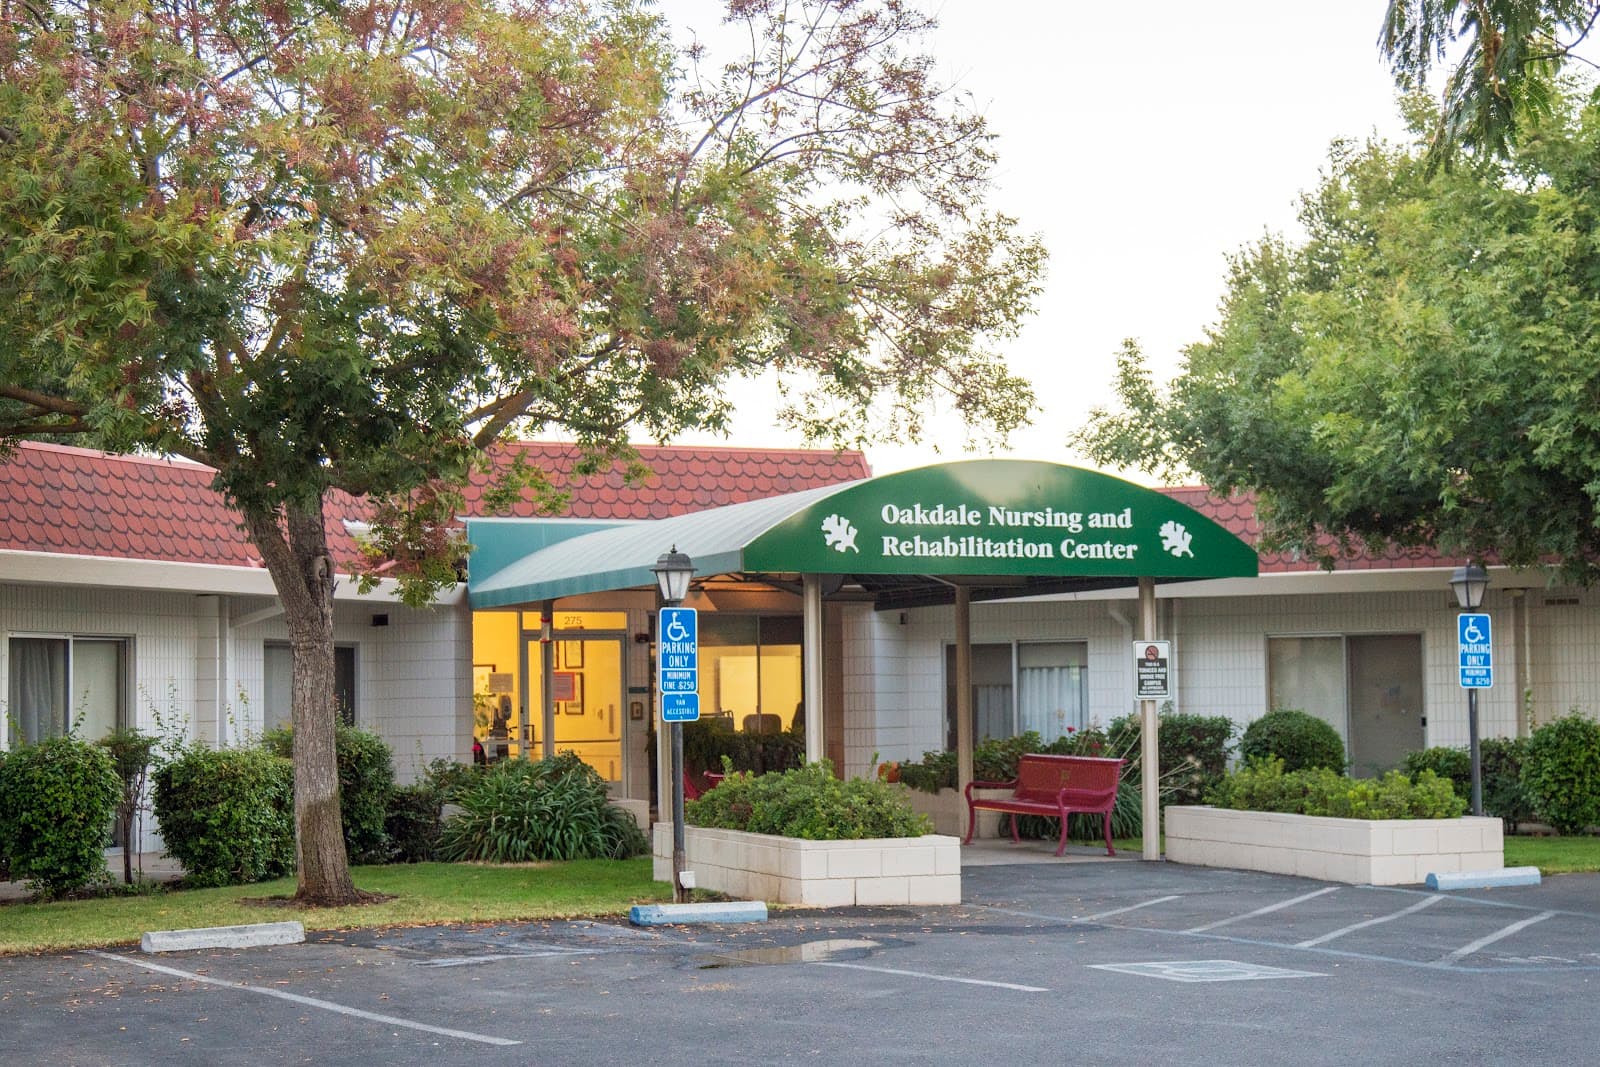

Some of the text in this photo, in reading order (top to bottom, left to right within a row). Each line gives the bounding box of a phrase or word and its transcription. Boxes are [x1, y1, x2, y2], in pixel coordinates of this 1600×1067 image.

[881, 503, 1133, 534] Oakdale Nursing and
[881, 535, 1138, 559] Rehabilitation Center
[564, 616, 582, 625] 275
[662, 641, 696, 654] PARKING
[1460, 643, 1490, 655] PARKING
[668, 655, 689, 668] ONLY
[1466, 655, 1485, 666] ONLY
[666, 671, 691, 680] MINIMUM
[663, 681, 676, 690] FINE
